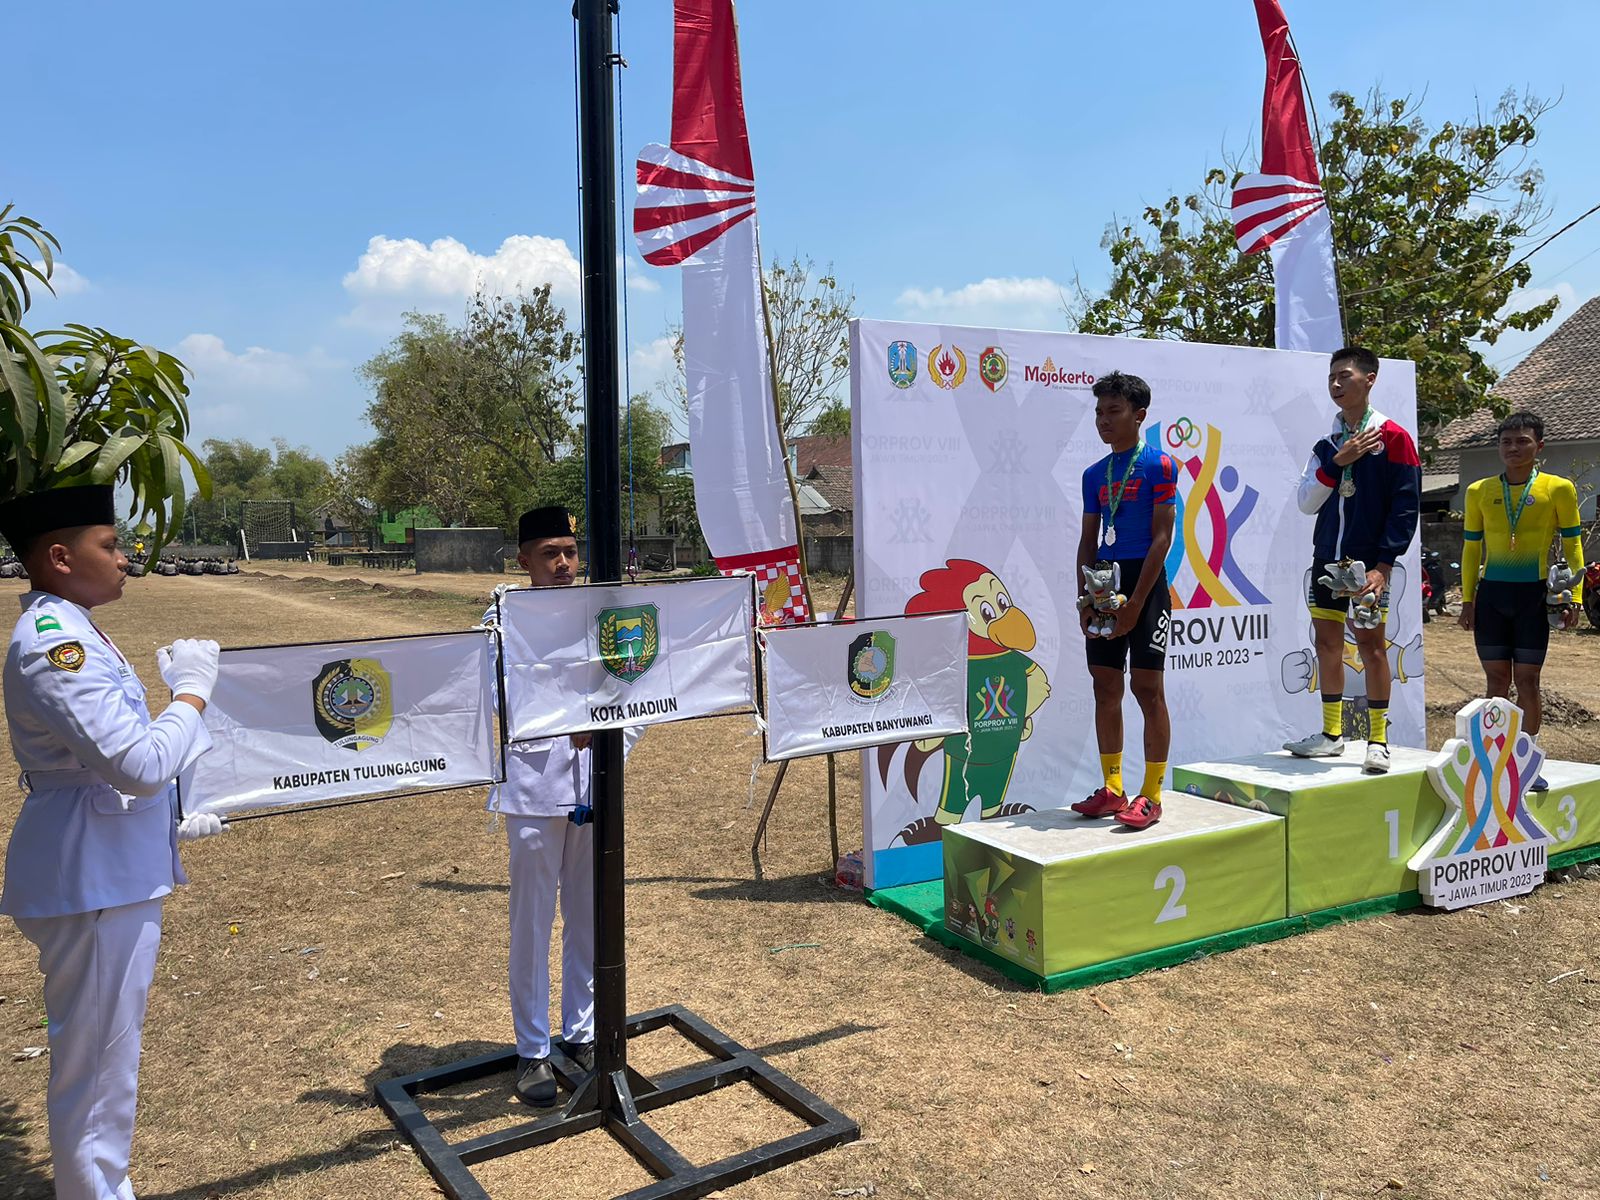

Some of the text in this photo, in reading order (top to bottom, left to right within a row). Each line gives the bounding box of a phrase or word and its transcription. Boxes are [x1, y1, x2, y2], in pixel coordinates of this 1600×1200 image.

[1025, 365, 1095, 387] Mojokerto
[863, 434, 961, 452] ORPROV VIII
[1149, 609, 1170, 653] ISSI
[1231, 613, 1268, 641] VIII
[1170, 648, 1249, 670] TIMUR 2023
[590, 697, 678, 722] KOTA MADIUN
[974, 719, 1006, 729] PORPROV
[1008, 717, 1018, 726] VIII
[821, 714, 933, 738] KABUPATEN BANYUWANGI
[334, 735, 380, 748] TULUNGAGUNG
[273, 758, 446, 790] KABUPATEN TULUNGAGUNG
[1556, 794, 1578, 842] 3
[1384, 809, 1400, 860] 1
[1434, 845, 1544, 886] PORPROV VIII
[1153, 864, 1187, 924] 2
[1448, 873, 1531, 902] JAWA TIMUR 2023
